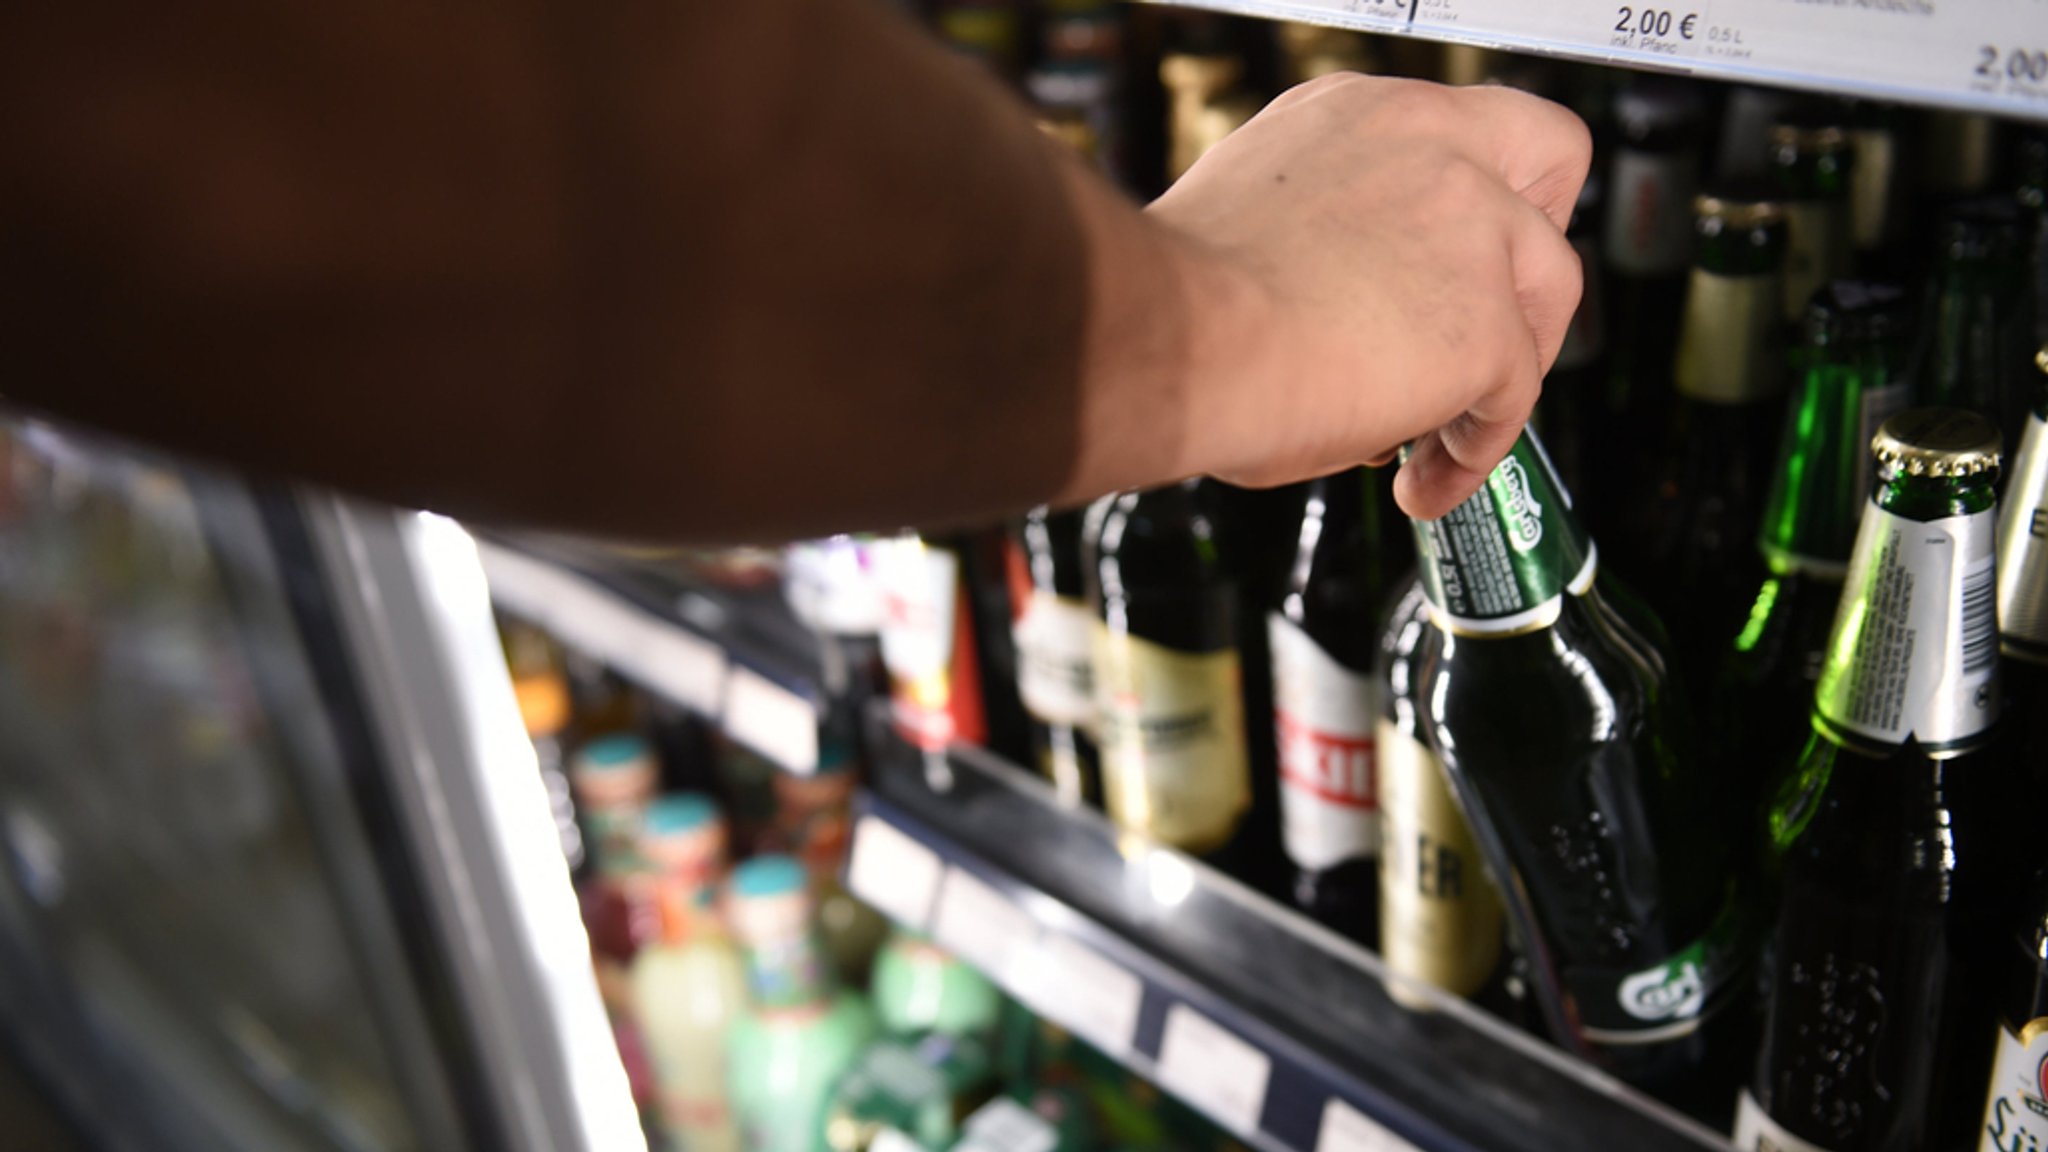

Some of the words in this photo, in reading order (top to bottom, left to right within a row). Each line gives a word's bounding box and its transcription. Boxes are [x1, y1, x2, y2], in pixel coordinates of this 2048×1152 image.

[1614, 6, 1671, 38] 2,00
[1679, 13, 1698, 39] €
[1974, 45, 2048, 81] 2,00
